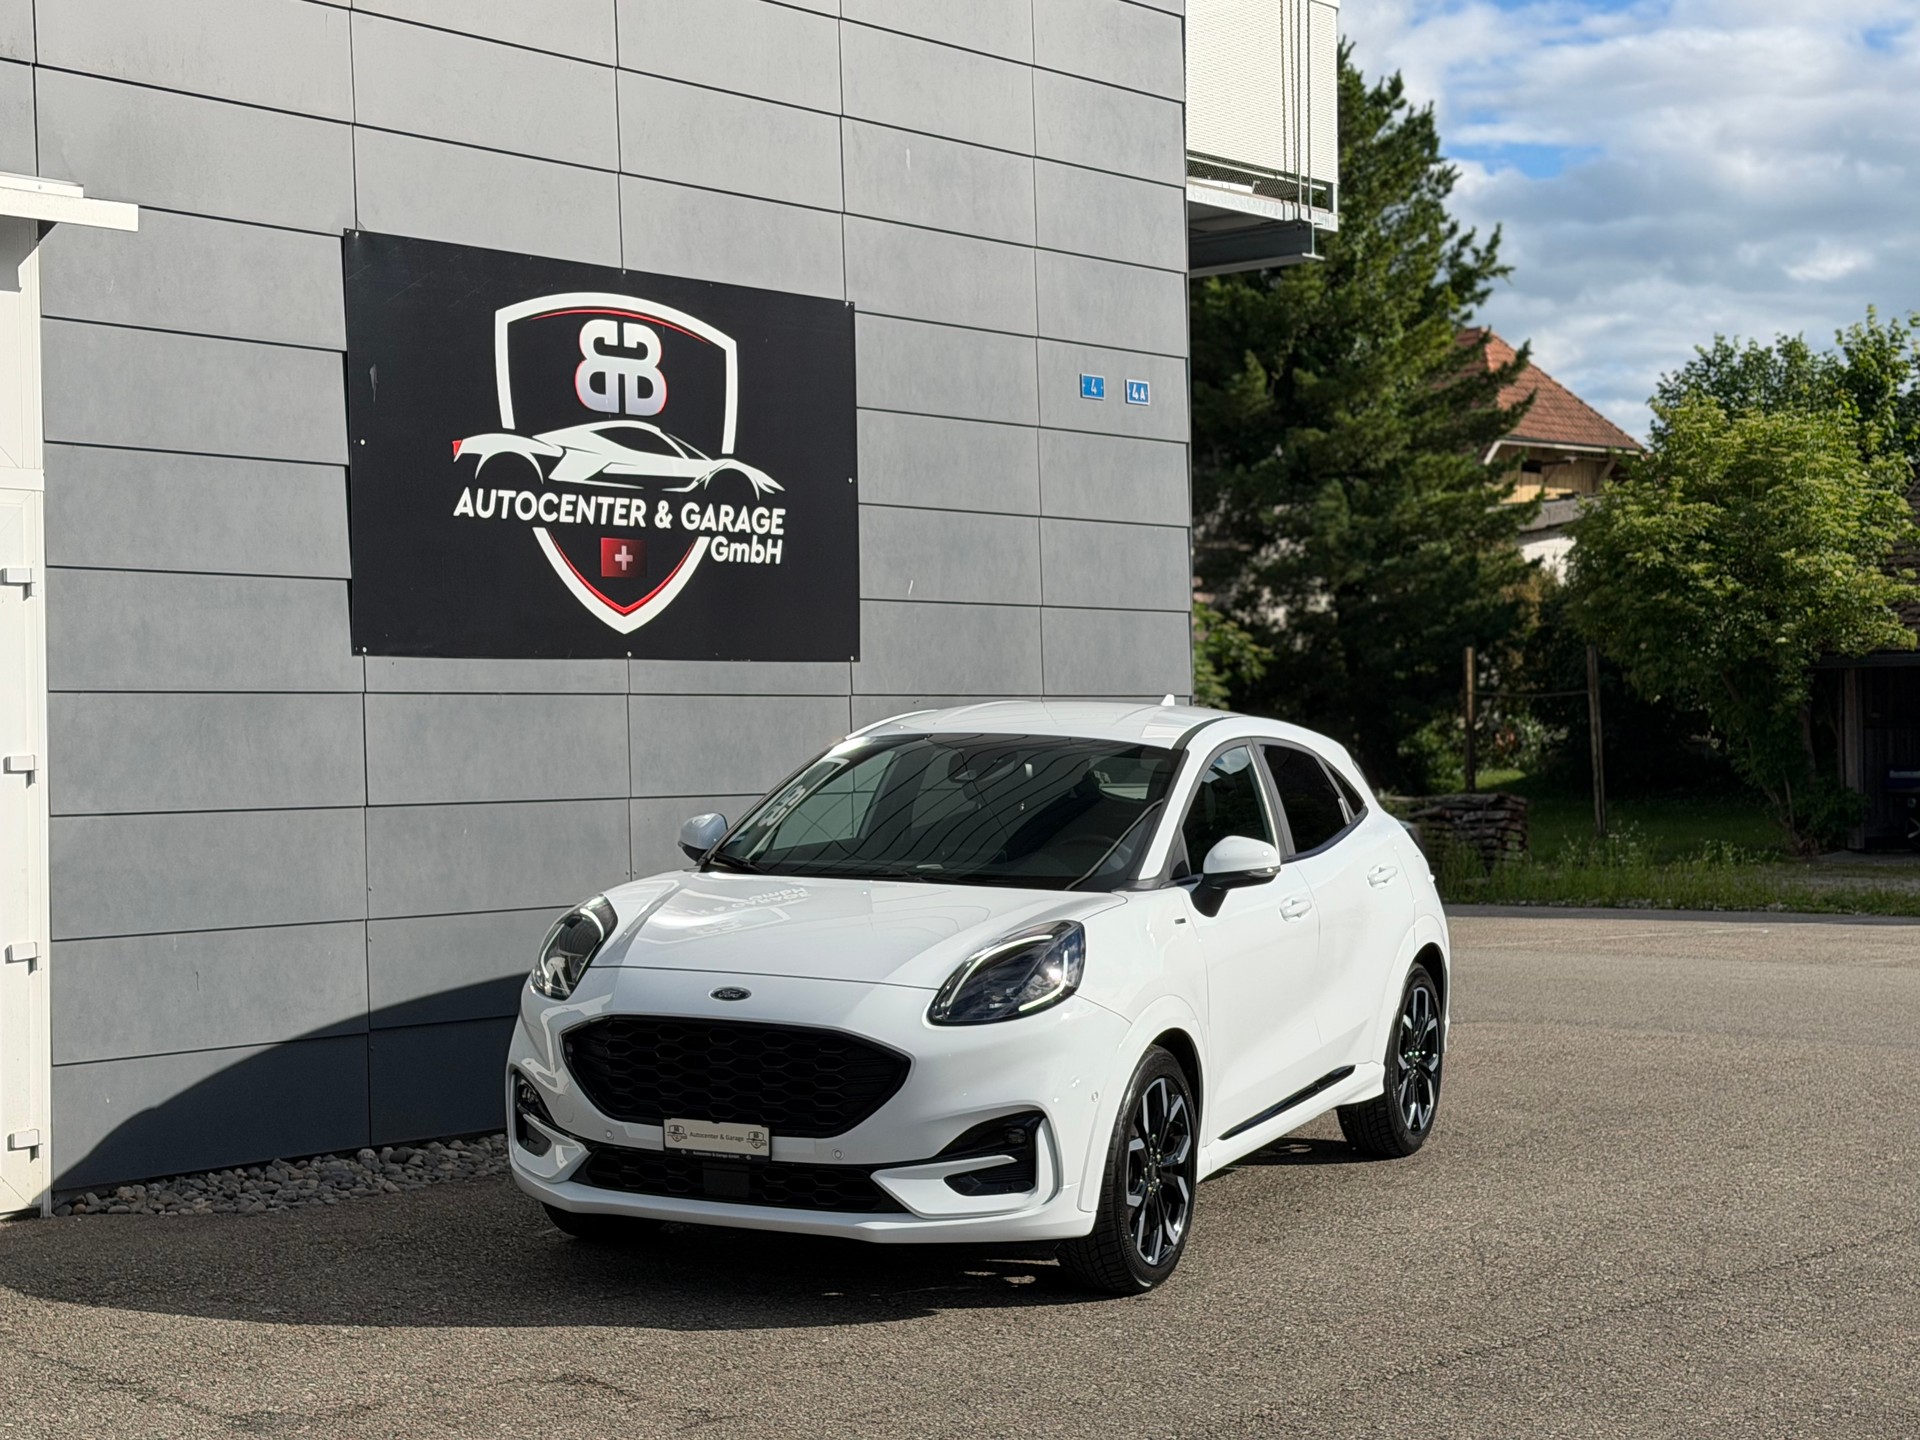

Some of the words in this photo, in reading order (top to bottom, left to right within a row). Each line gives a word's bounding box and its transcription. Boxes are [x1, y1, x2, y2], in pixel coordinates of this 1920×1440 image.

[1090, 378, 1097, 394] 4
[453, 486, 647, 529] AUTOCENTER
[654, 499, 674, 530] &
[680, 501, 786, 536] GARAGE
[710, 535, 783, 565] GmbH
[690, 1131, 718, 1139] Autocenter
[726, 1134, 744, 1142] Garage
